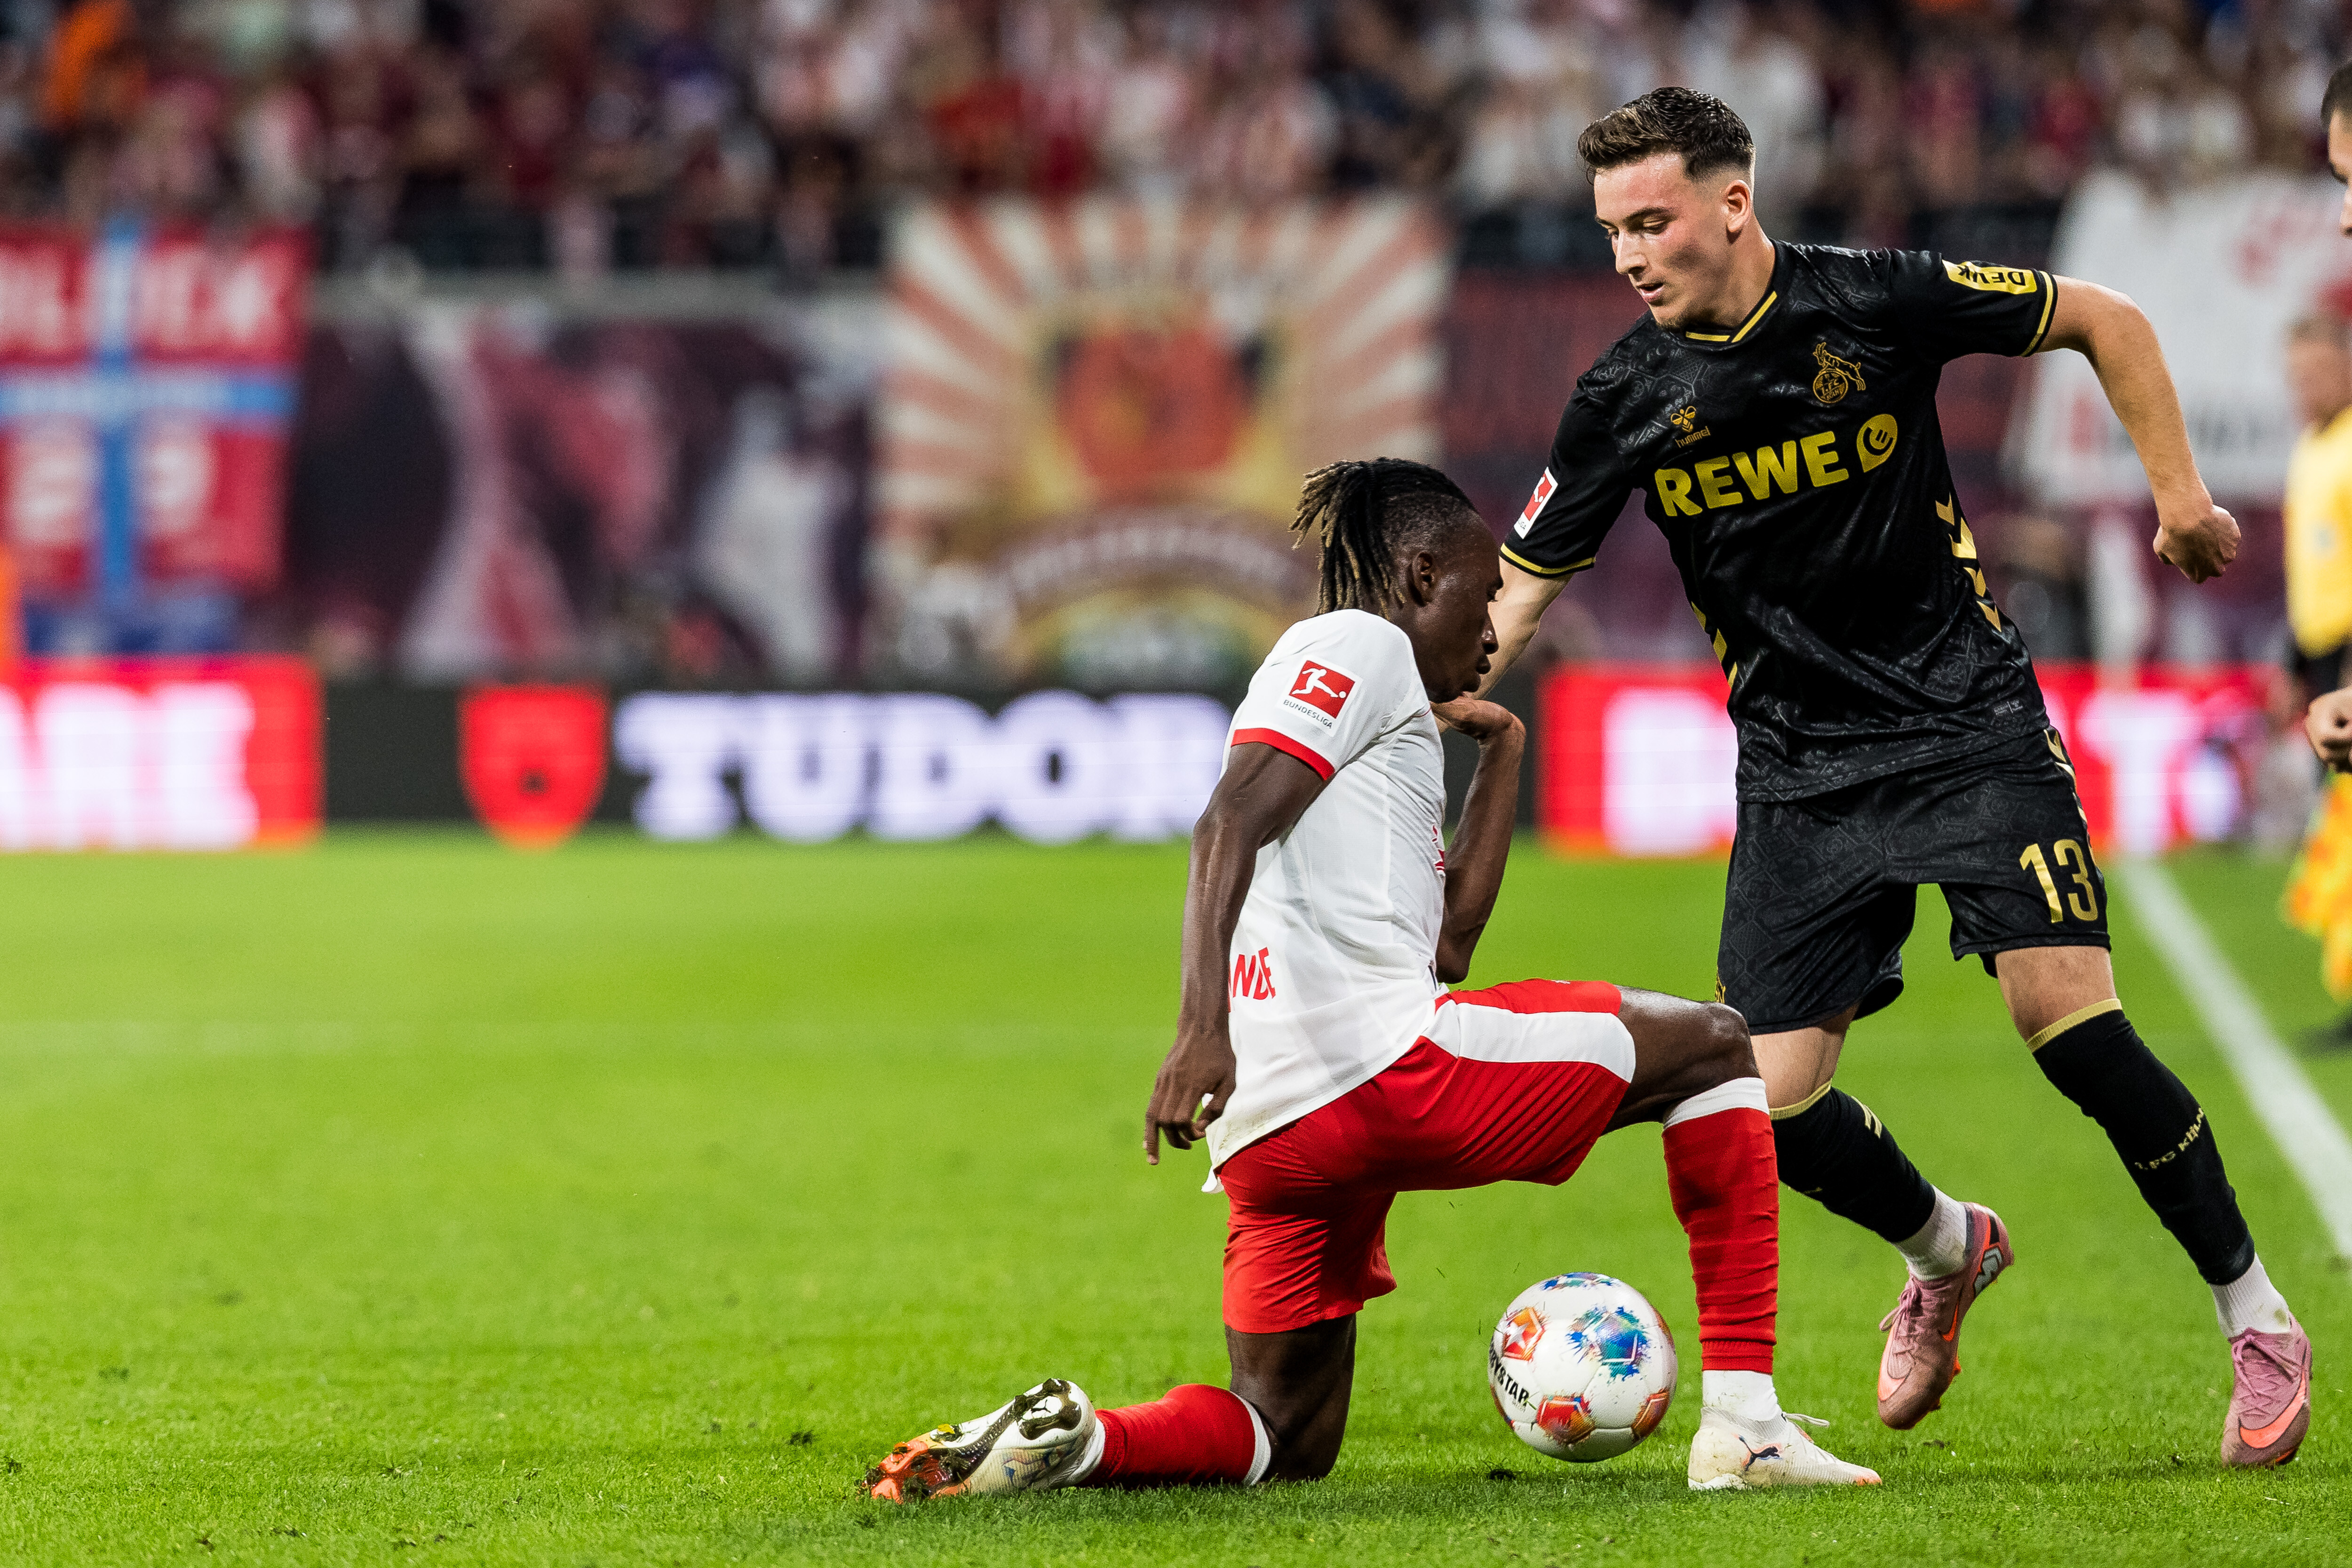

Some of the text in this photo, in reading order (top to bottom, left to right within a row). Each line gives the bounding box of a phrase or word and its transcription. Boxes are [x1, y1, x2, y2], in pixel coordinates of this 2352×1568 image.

[1957, 265, 2026, 286] DEVK
[1675, 426, 1711, 448] hummel
[1654, 430, 1849, 517] REWE
[1283, 699, 1333, 729] BUNDESLIGA
[613, 691, 1233, 843] TUDOR
[2019, 839, 2098, 923] 13
